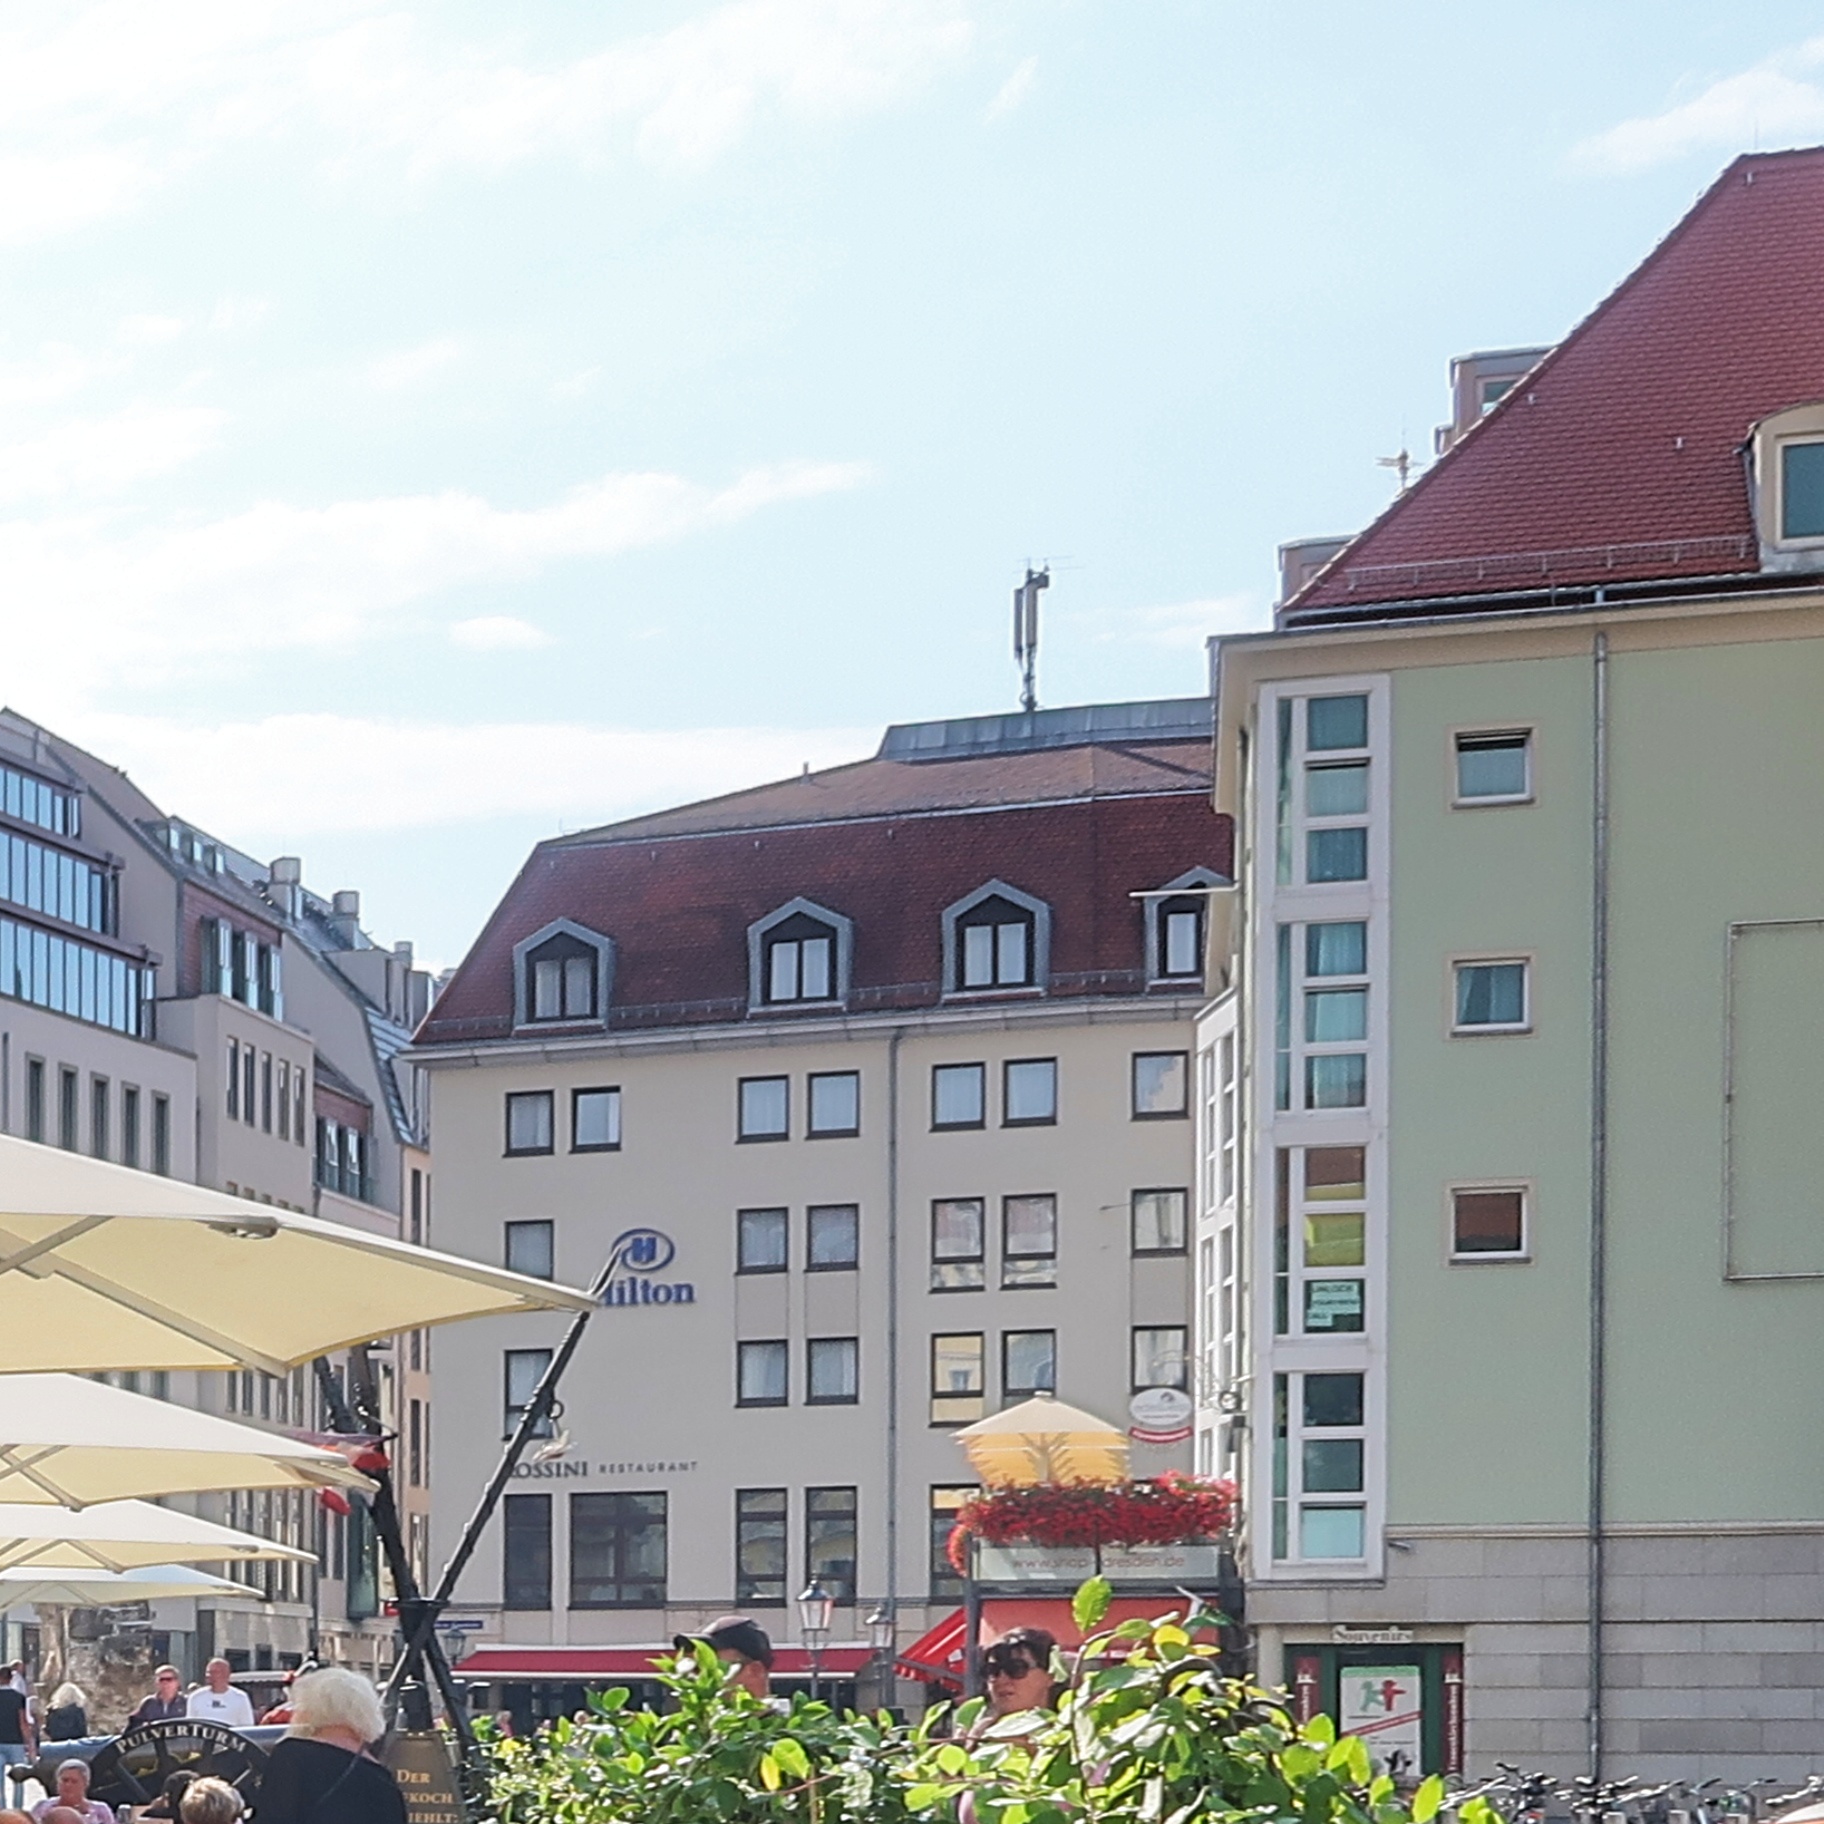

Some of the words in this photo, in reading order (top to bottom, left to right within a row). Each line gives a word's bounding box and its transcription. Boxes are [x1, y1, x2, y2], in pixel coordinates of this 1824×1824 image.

[599, 1461, 697, 1474] RESTAURANT
[115, 1723, 247, 1754] PULVERTURM
[396, 1769, 430, 1783] DER
[408, 1813, 458, 1824] IEHLT:
